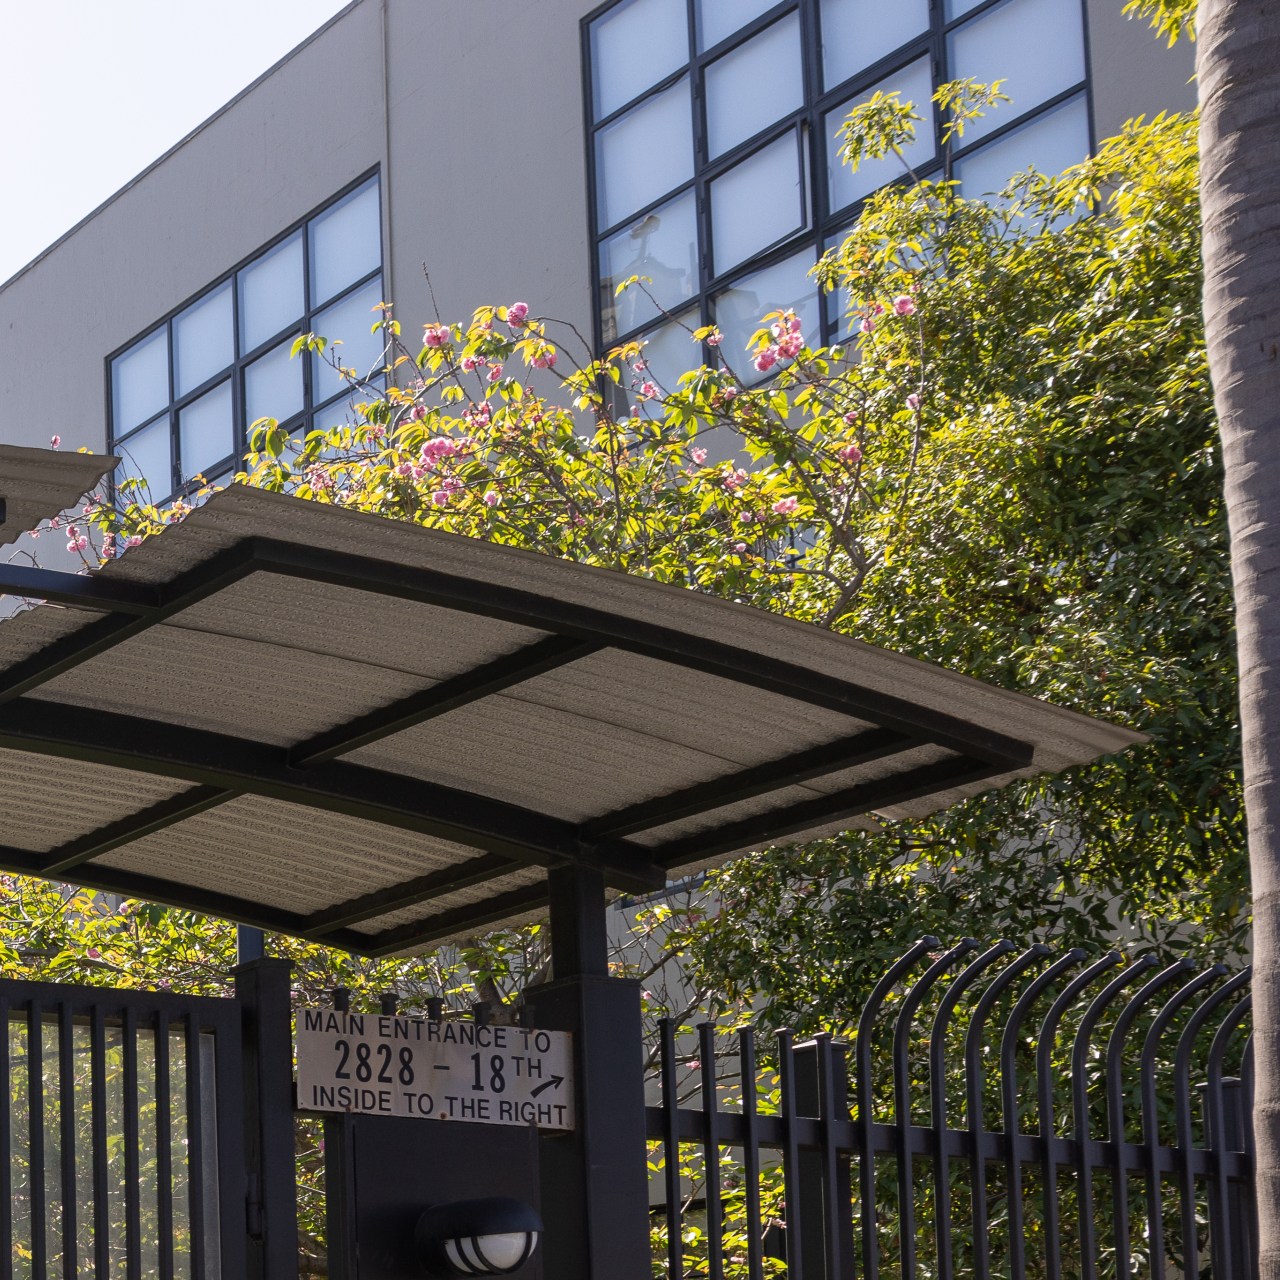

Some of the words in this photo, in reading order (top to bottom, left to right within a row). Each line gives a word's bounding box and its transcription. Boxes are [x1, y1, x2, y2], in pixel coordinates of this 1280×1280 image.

[305, 1010, 364, 1036] MAIN
[378, 1017, 507, 1048] ENTRANCE
[520, 1030, 551, 1053] TO
[335, 1040, 415, 1086] 2828
[313, 1085, 391, 1112] INSIDE
[403, 1092, 434, 1115] TO
[444, 1096, 490, 1119] THE
[500, 1100, 567, 1125] RIGHT
